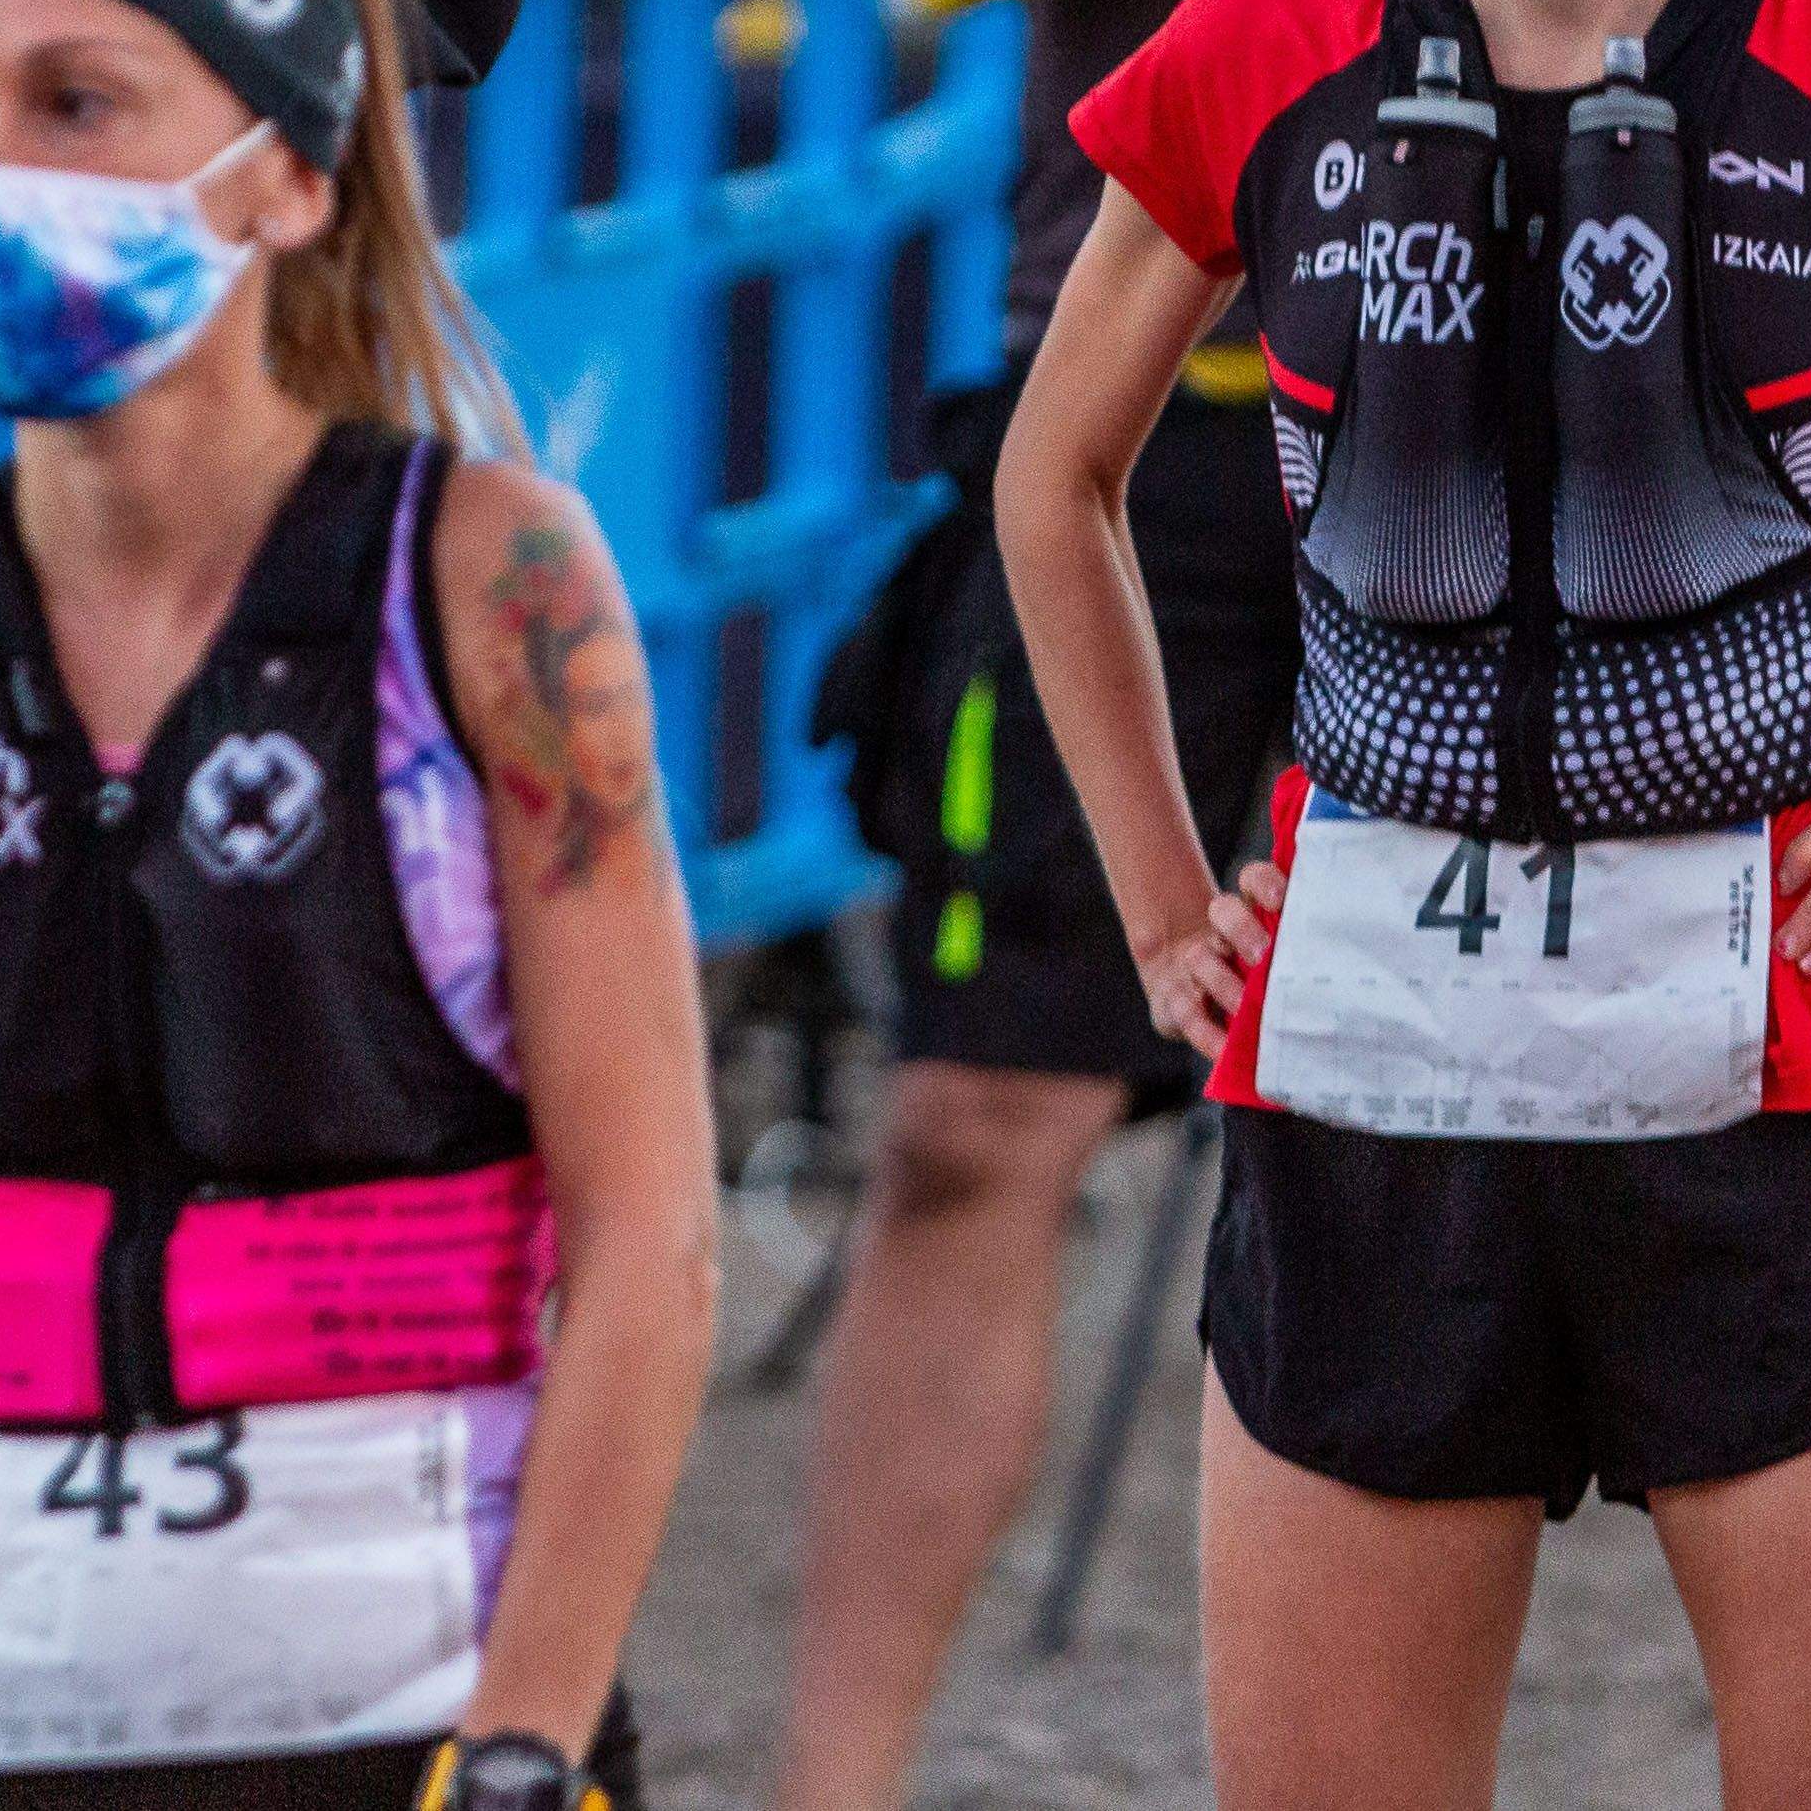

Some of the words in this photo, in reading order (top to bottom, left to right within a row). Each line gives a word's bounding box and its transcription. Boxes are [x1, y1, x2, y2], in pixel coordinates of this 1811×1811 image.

[1360, 219, 1474, 283] RCh
[1359, 281, 1486, 344] MAX
[1415, 835, 1577, 959] 41
[39, 1411, 252, 1537] 43
